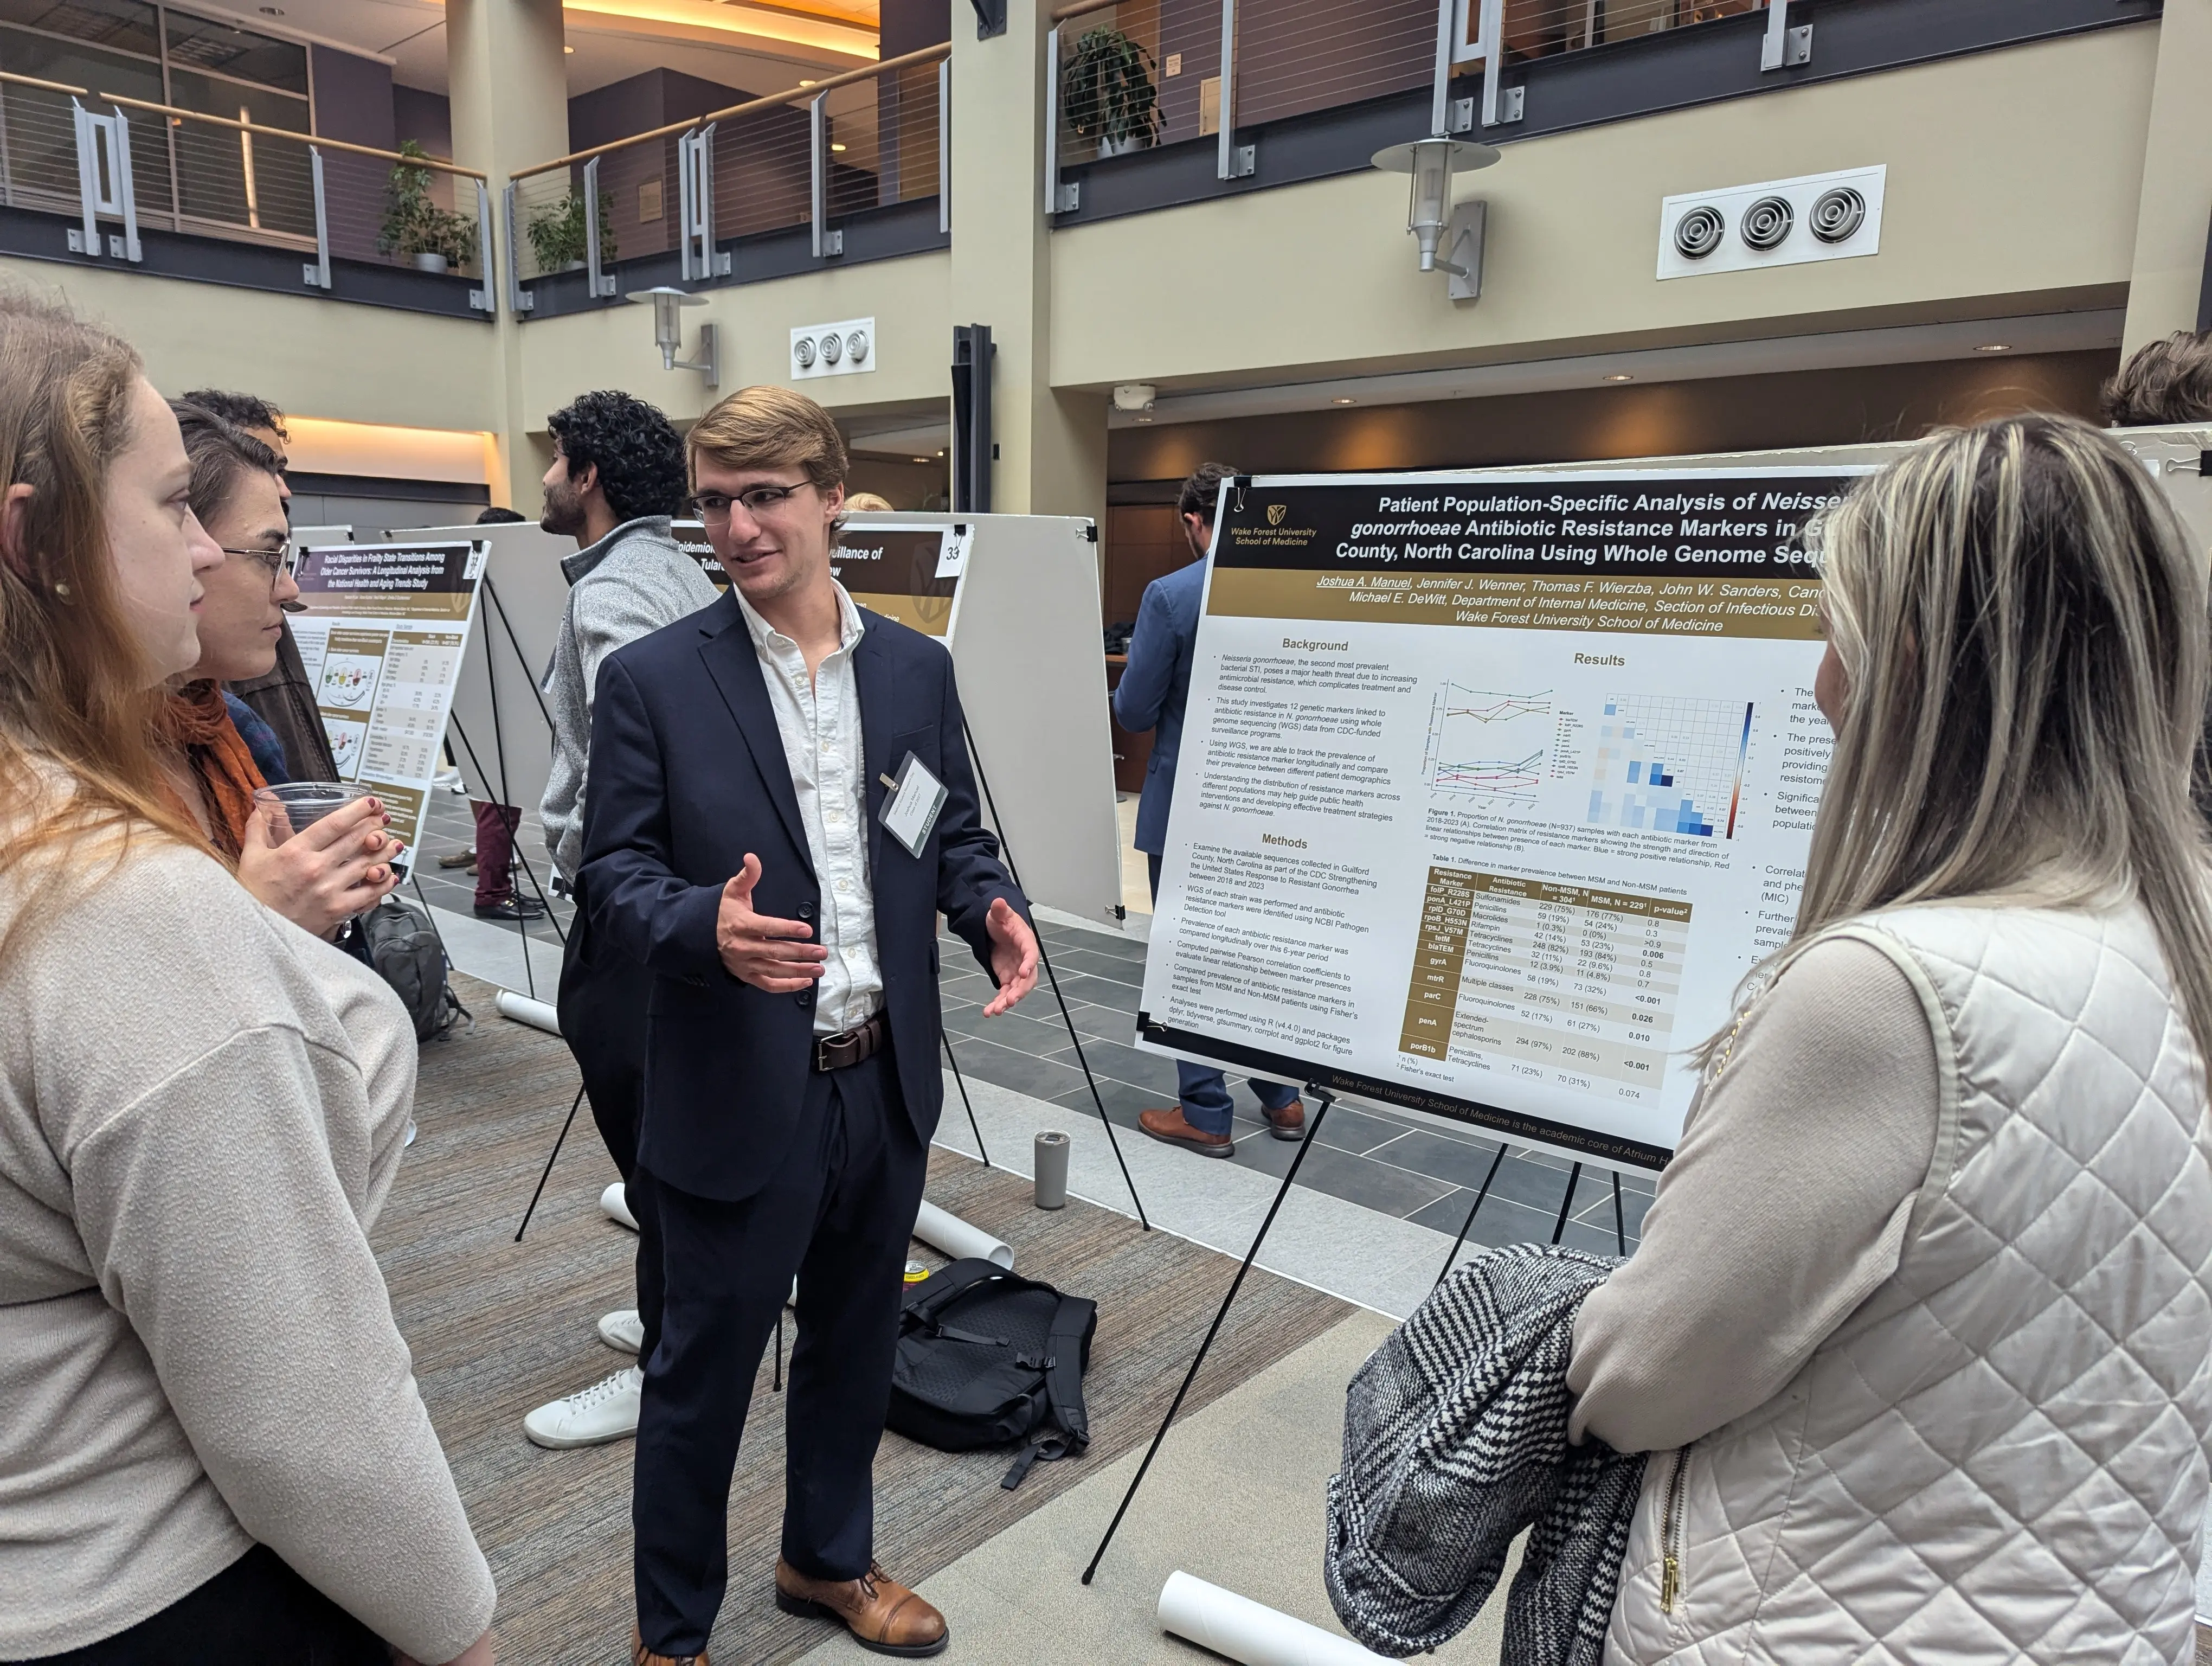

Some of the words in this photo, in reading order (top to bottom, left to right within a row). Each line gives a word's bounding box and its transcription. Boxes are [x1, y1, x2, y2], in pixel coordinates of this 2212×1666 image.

[1379, 497, 1439, 512] Patient
[1443, 494, 1629, 515] Population-Specific
[1632, 493, 1725, 515] Analysis
[1732, 492, 1758, 510] of
[1231, 527, 1251, 537] Wake
[1253, 527, 1277, 538] Forest
[1278, 527, 1317, 539] University
[1350, 520, 1461, 539] gonorrhoeae
[1464, 520, 1555, 536] Antibiotic
[1561, 520, 1673, 536] Resistance
[1680, 519, 1767, 536] Markers
[1776, 519, 1796, 536] in
[677, 541, 715, 553] pidemiol
[1262, 537, 1271, 545] of
[1272, 537, 1308, 546] Medicine
[325, 555, 338, 563] Racial
[338, 554, 362, 565] Disparities
[368, 553, 383, 564] Frailty
[383, 553, 396, 562] State
[397, 552, 425, 562] Transitions
[425, 552, 445, 563] Among
[872, 547, 884, 560] of
[1336, 542, 1398, 562] County,
[1404, 543, 1452, 559] North
[1458, 543, 1534, 560] Carolina
[1541, 544, 1597, 565] Using
[1604, 544, 1668, 562] Whole
[1675, 545, 1766, 563] Genome
[320, 567, 332, 575] Older
[333, 566, 349, 575] Cancer
[372, 566, 377, 575] A
[377, 565, 408, 576] Longitudinal
[408, 565, 430, 576] Analysis
[430, 565, 444, 574] from
[829, 567, 841, 576] ew
[336, 579, 354, 587] National
[354, 578, 369, 587] Health
[369, 578, 380, 587] and
[379, 578, 394, 589] Aging
[395, 578, 411, 587] Trends
[412, 578, 428, 589] Study
[1317, 576, 1354, 587] Joshua
[1355, 577, 1368, 587] A.
[1371, 578, 1412, 589] Manuel,
[1417, 578, 1463, 589] Jennifer
[1464, 579, 1472, 589] J.
[1480, 579, 1526, 592] Wenner,
[1533, 580, 1580, 592] Thomas
[1584, 581, 1594, 592] F.
[1600, 582, 1654, 595] Wierzba,
[1659, 583, 1692, 594] John
[1698, 584, 1714, 595] W.
[1720, 584, 1780, 599] Sanders,
[1349, 591, 1392, 603] Michael
[1393, 592, 1404, 603] E.
[1407, 593, 1447, 606] DeWitt,
[1451, 594, 1521, 608] Department
[1523, 596, 1538, 607] of
[1538, 597, 1586, 609] Internal
[1587, 598, 1648, 613] Medicine,
[1654, 600, 1705, 613] Section
[1708, 601, 1725, 613] of
[1725, 602, 1796, 616] Infectious
[1456, 610, 1488, 622] Wake
[1491, 612, 1530, 624] Forest
[1533, 613, 1594, 629] University
[1597, 616, 1643, 628] School
[1645, 617, 1661, 629] of
[1661, 618, 1723, 631] Medicine
[1282, 638, 1348, 652] Background
[1221, 654, 1251, 662] Neisseria
[1252, 657, 1296, 667] gonorrhoeae,
[1355, 663, 1389, 671] prevalent
[1574, 652, 1625, 666] Results
[1220, 663, 1248, 672] bacterial
[1249, 665, 1262, 674] STI,
[1291, 669, 1310, 677] major
[1311, 669, 1333, 677] health
[1334, 671, 1355, 679] threat
[1380, 674, 1417, 684] increasing
[1787, 733, 1806, 742] The
[1809, 736, 1836, 745] prese
[1784, 748, 1831, 760] positively
[1782, 761, 1828, 773] providing
[911, 785, 919, 802] Manuel
[1777, 791, 1819, 803] Significa
[1775, 805, 1817, 817] between
[922, 805, 937, 835] STUDENT
[1262, 834, 1308, 849] Methods
[1432, 854, 1449, 862] Table
[1458, 857, 1489, 867] Difference
[1521, 867, 1556, 876] prevalence
[1558, 871, 1586, 881] between
[1587, 875, 1606, 884] MSM
[1622, 880, 1657, 891] Non-MSM
[1658, 887, 1687, 895] patients
[1431, 886, 1470, 898] folP_R228S
[1763, 881, 1782, 889] and
[1784, 882, 1804, 892] phe
[1476, 893, 1520, 906] Sulfonamides
[1761, 892, 1789, 905] (MIC)
[1539, 902, 1552, 911] 229
[1554, 905, 1575, 915] (75%)
[1586, 909, 1599, 918] 176
[1601, 912, 1623, 923] (77%)
[1758, 911, 1794, 923] Further
[1647, 919, 1659, 927] 0.8
[1333, 1074, 1354, 1087] Wake
[1356, 1081, 1382, 1094] Forest
[1385, 1088, 1425, 1104] University
[1427, 1098, 1457, 1113] School
[1470, 1109, 1509, 1126] Medicine
[1512, 1119, 1520, 1128] is
[1522, 1122, 1536, 1132] the
[1539, 1128, 1585, 1144] academic
[1587, 1140, 1609, 1150] core
[1611, 1145, 1623, 1154] of
[1623, 1147, 1656, 1162] Atrium
[1660, 1156, 1670, 1165] H
